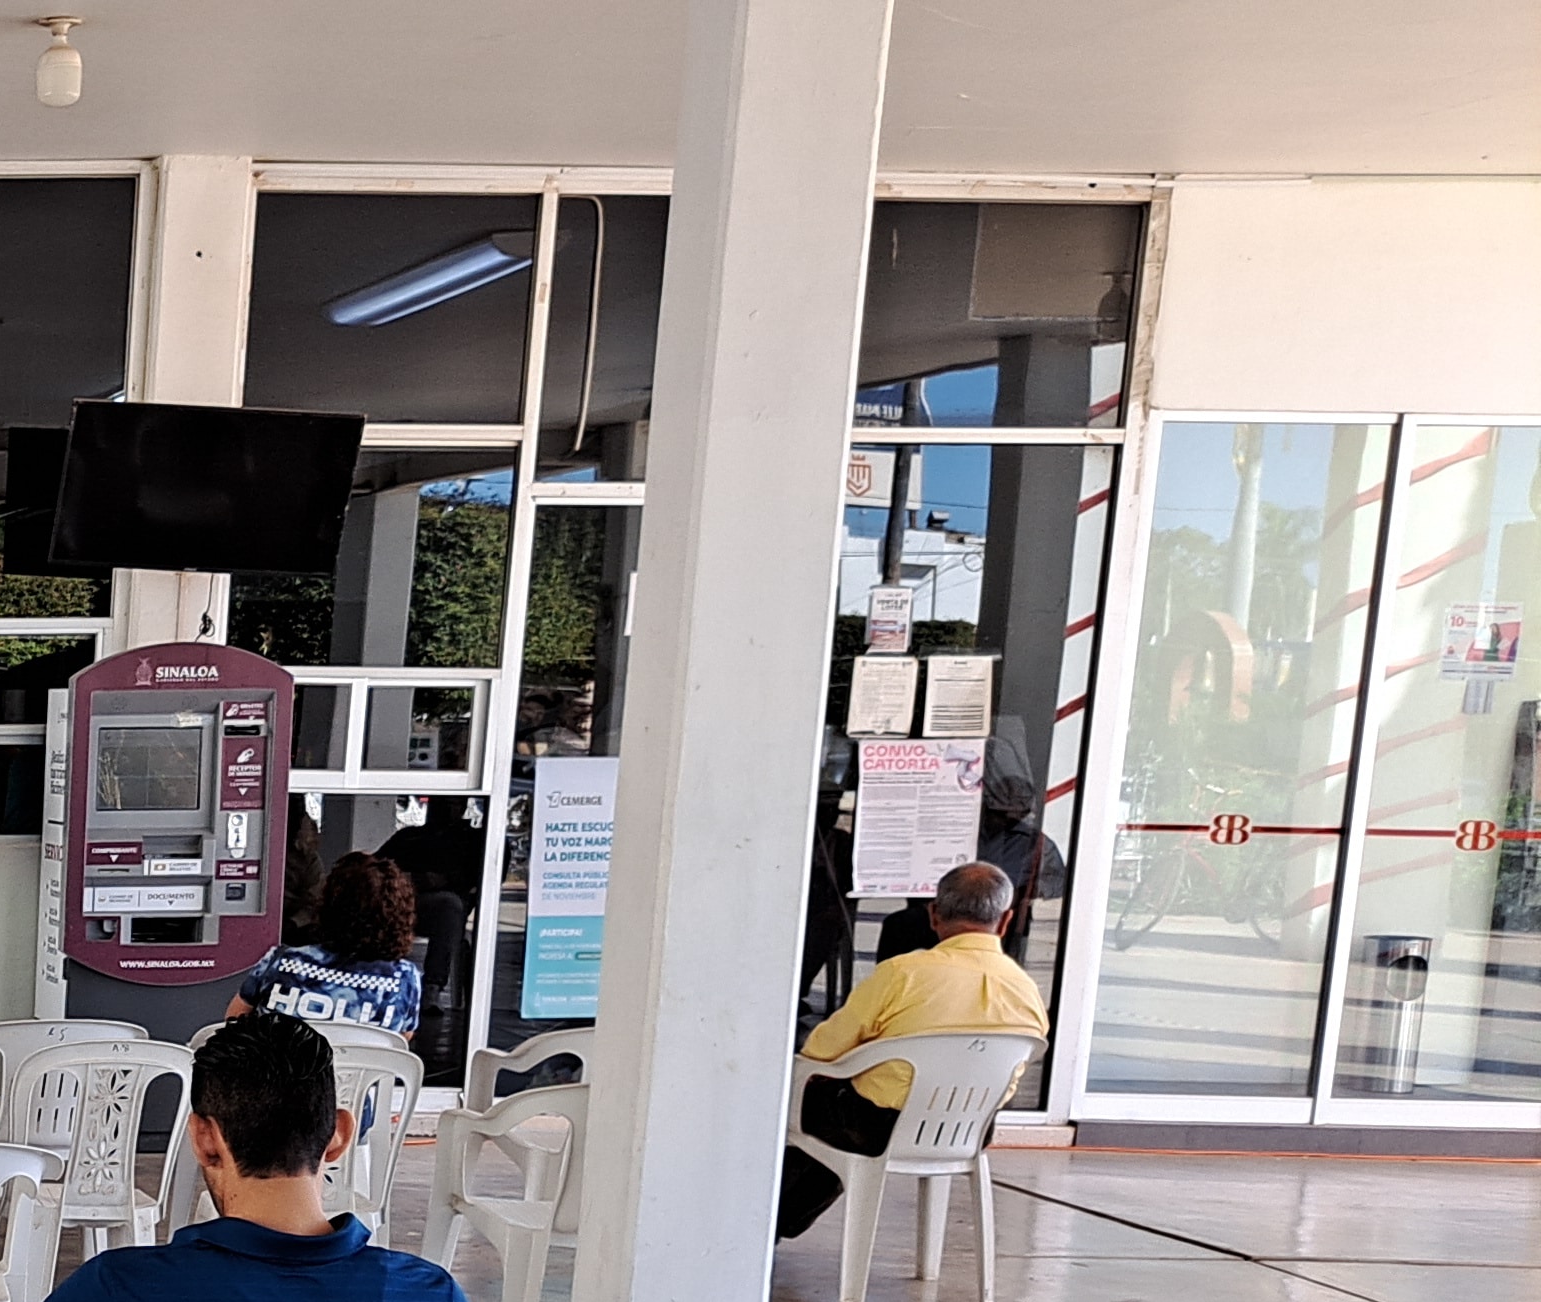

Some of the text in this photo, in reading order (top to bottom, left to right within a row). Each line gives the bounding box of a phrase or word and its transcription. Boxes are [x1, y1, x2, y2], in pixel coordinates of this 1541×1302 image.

[155, 666, 219, 678] SINALOA
[863, 745, 926, 757] CONVO
[863, 758, 940, 771] CATORIA
[561, 796, 603, 806] CEMERGE
[545, 822, 614, 832] HAZTE ESCUC
[545, 837, 613, 847] TU VOZ MARC
[544, 851, 611, 862] LA DIFERENC
[575, 881, 608, 889] REGULAT
